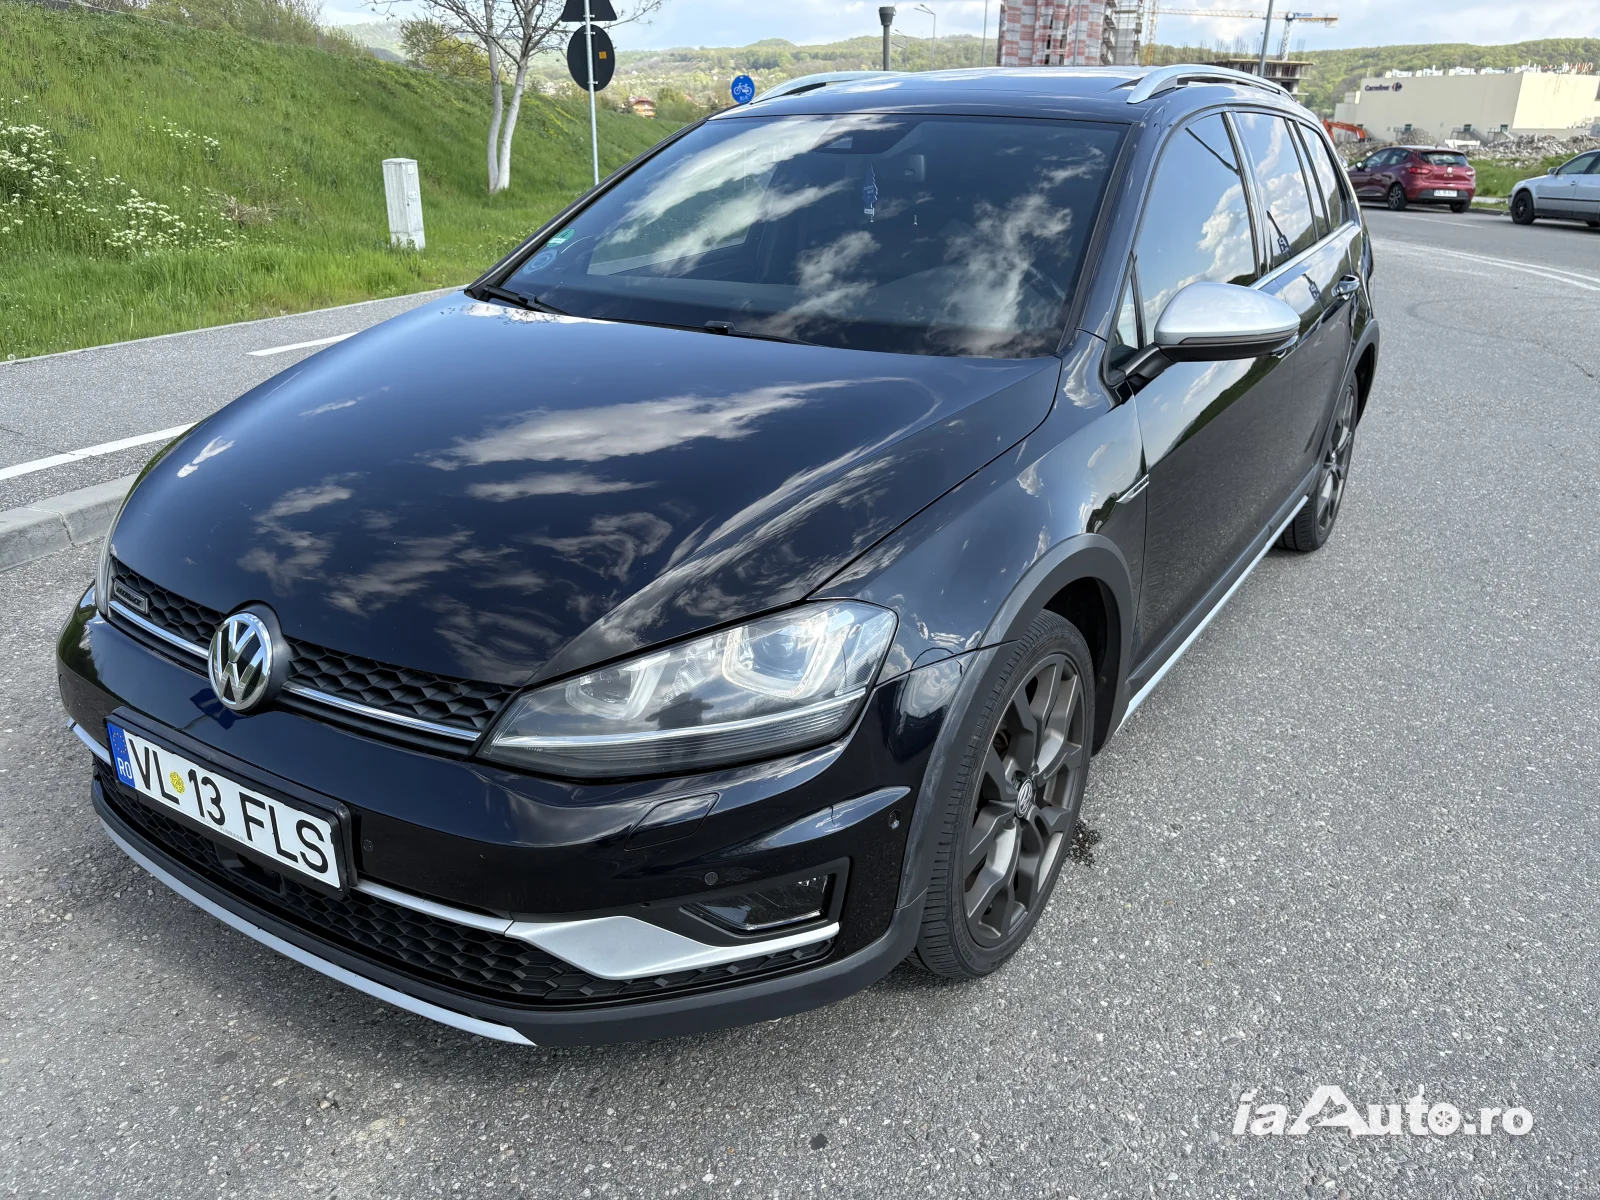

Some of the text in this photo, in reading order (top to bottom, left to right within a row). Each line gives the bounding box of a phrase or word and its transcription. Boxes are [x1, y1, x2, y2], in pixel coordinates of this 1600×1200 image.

[117, 757, 133, 780] RO
[128, 738, 328, 874] VL 13 FLS
